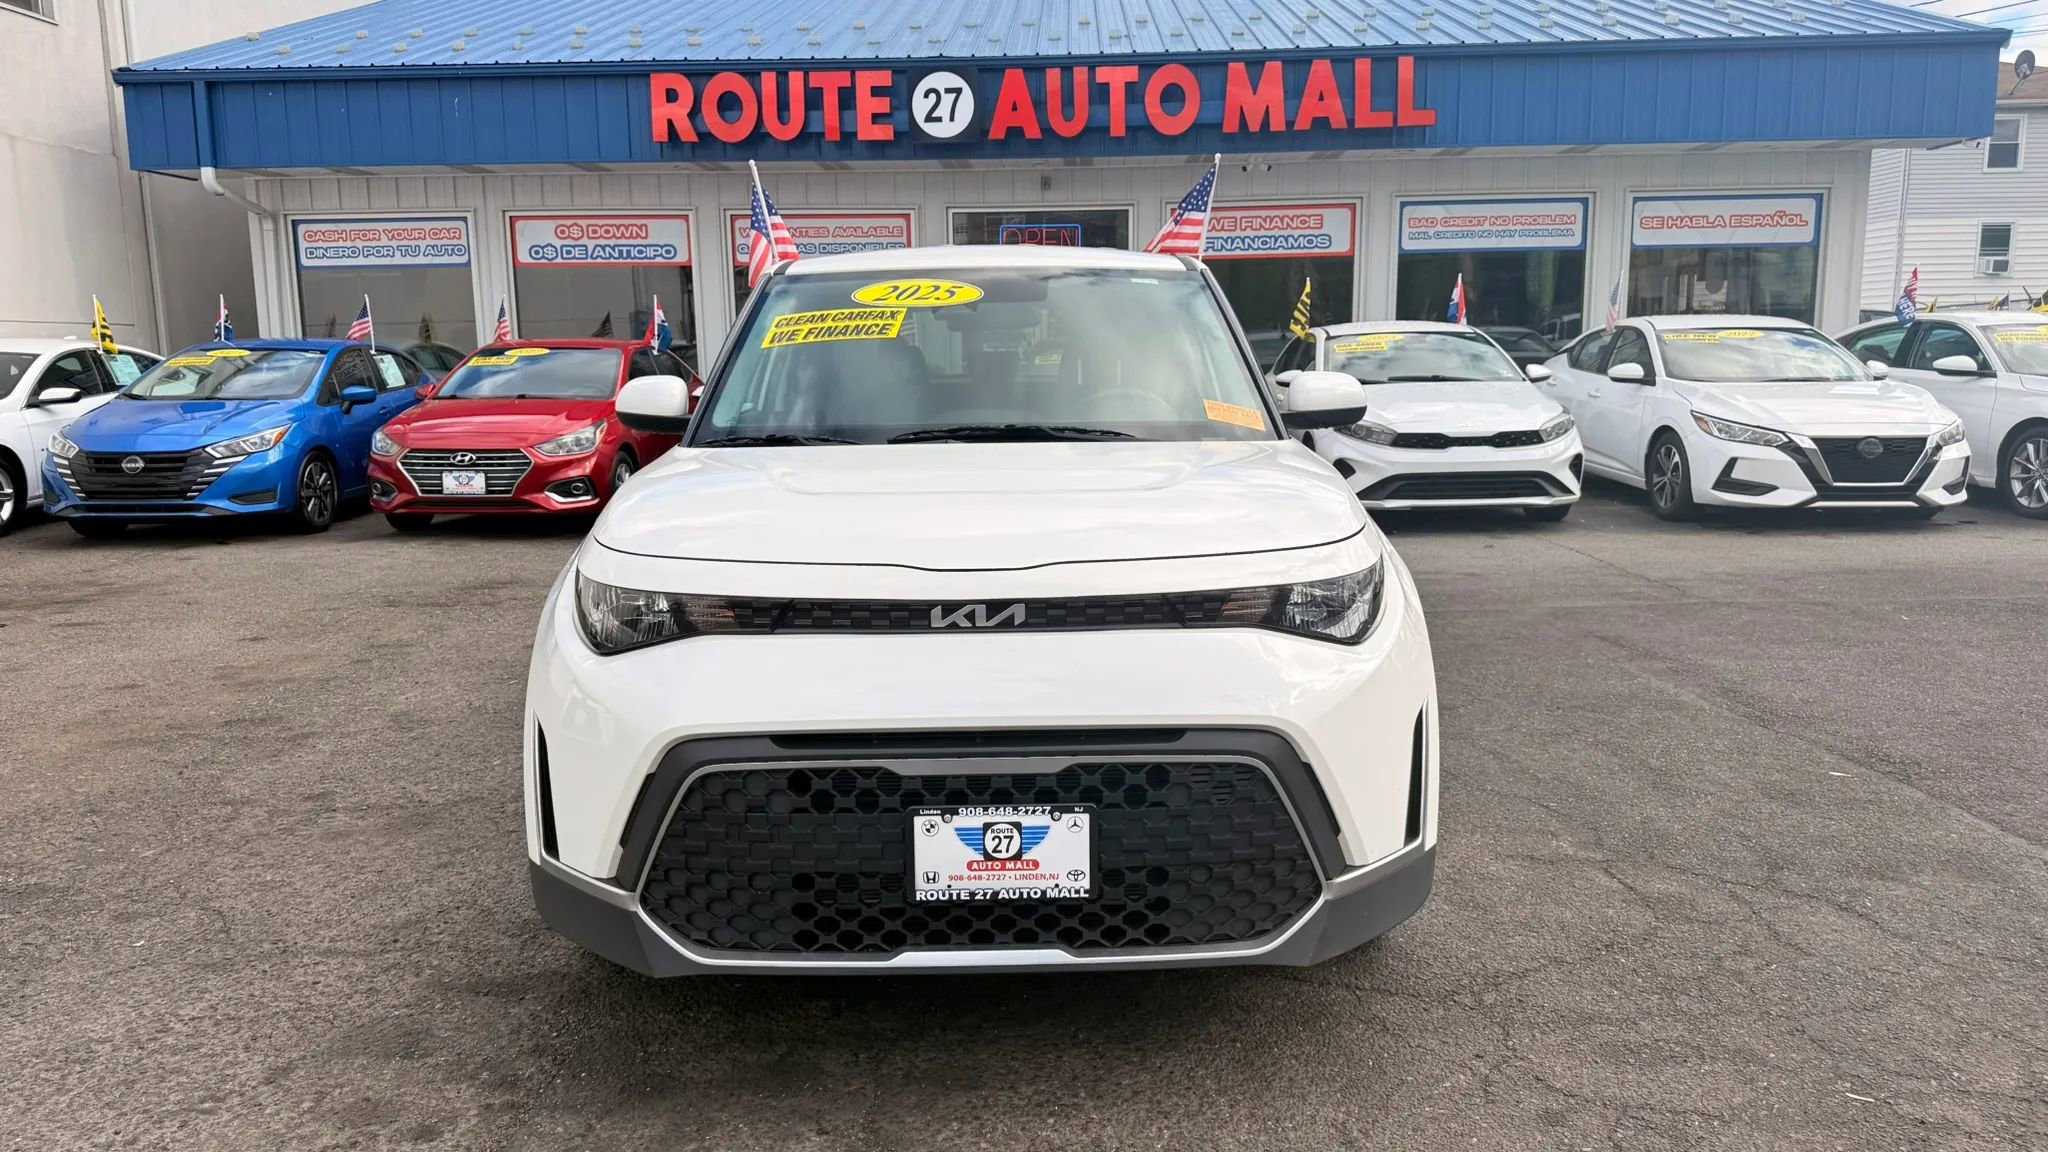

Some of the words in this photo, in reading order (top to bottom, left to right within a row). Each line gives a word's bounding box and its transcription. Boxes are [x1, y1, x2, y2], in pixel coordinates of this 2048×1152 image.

[649, 70, 895, 144] ROUTE
[922, 86, 964, 124] 27
[987, 63, 1201, 140] AUTO
[1222, 55, 1437, 134] MALL
[1239, 214, 1323, 231] FINANCE
[1408, 217, 1438, 229] BAD
[1439, 216, 1488, 228] CREDIT
[1489, 215, 1511, 227] NO
[1512, 213, 1576, 226] PROBLEM
[1640, 215, 1666, 229] SE
[1667, 215, 1726, 229] HABLA
[1729, 210, 1808, 228] ESPAÑOL
[304, 229, 347, 243] CASH
[349, 228, 381, 242] FOR
[382, 227, 426, 242] YOUR
[428, 227, 462, 241] CAR
[586, 223, 648, 240] DOWN
[832, 226, 904, 238] AVAILABLE
[1408, 231, 1432, 240] MAL
[1433, 230, 1476, 240] CREDITO
[1477, 229, 1494, 239] NO
[1494, 229, 1518, 239] HAY
[1518, 228, 1575, 238] PROBLEMA
[306, 246, 360, 259] DINERO
[362, 245, 394, 259] POR
[396, 244, 421, 257] TU
[422, 243, 468, 257] AUTO
[1204, 233, 1332, 252] FINANCIAMOS
[560, 244, 589, 260] DE
[590, 243, 678, 260] ANTICIPO
[872, 284, 964, 302] 2025
[774, 314, 828, 329] CLEAN
[830, 309, 901, 323] CARFAX
[768, 327, 800, 344] WE
[802, 323, 896, 340] FINANCE
[930, 603, 1026, 628] KIA
[958, 806, 1052, 818] 908-648-2727
[990, 827, 1014, 835] ROUTE
[991, 835, 1015, 854] 27
[971, 860, 1001, 870] AUTO
[1005, 859, 1036, 870] MALL
[947, 873, 1007, 882] 908-648-2727
[916, 889, 970, 901] ROUTE
[974, 889, 993, 900] 27
[998, 887, 1042, 899] AUTO
[1046, 886, 1089, 898] MALL
